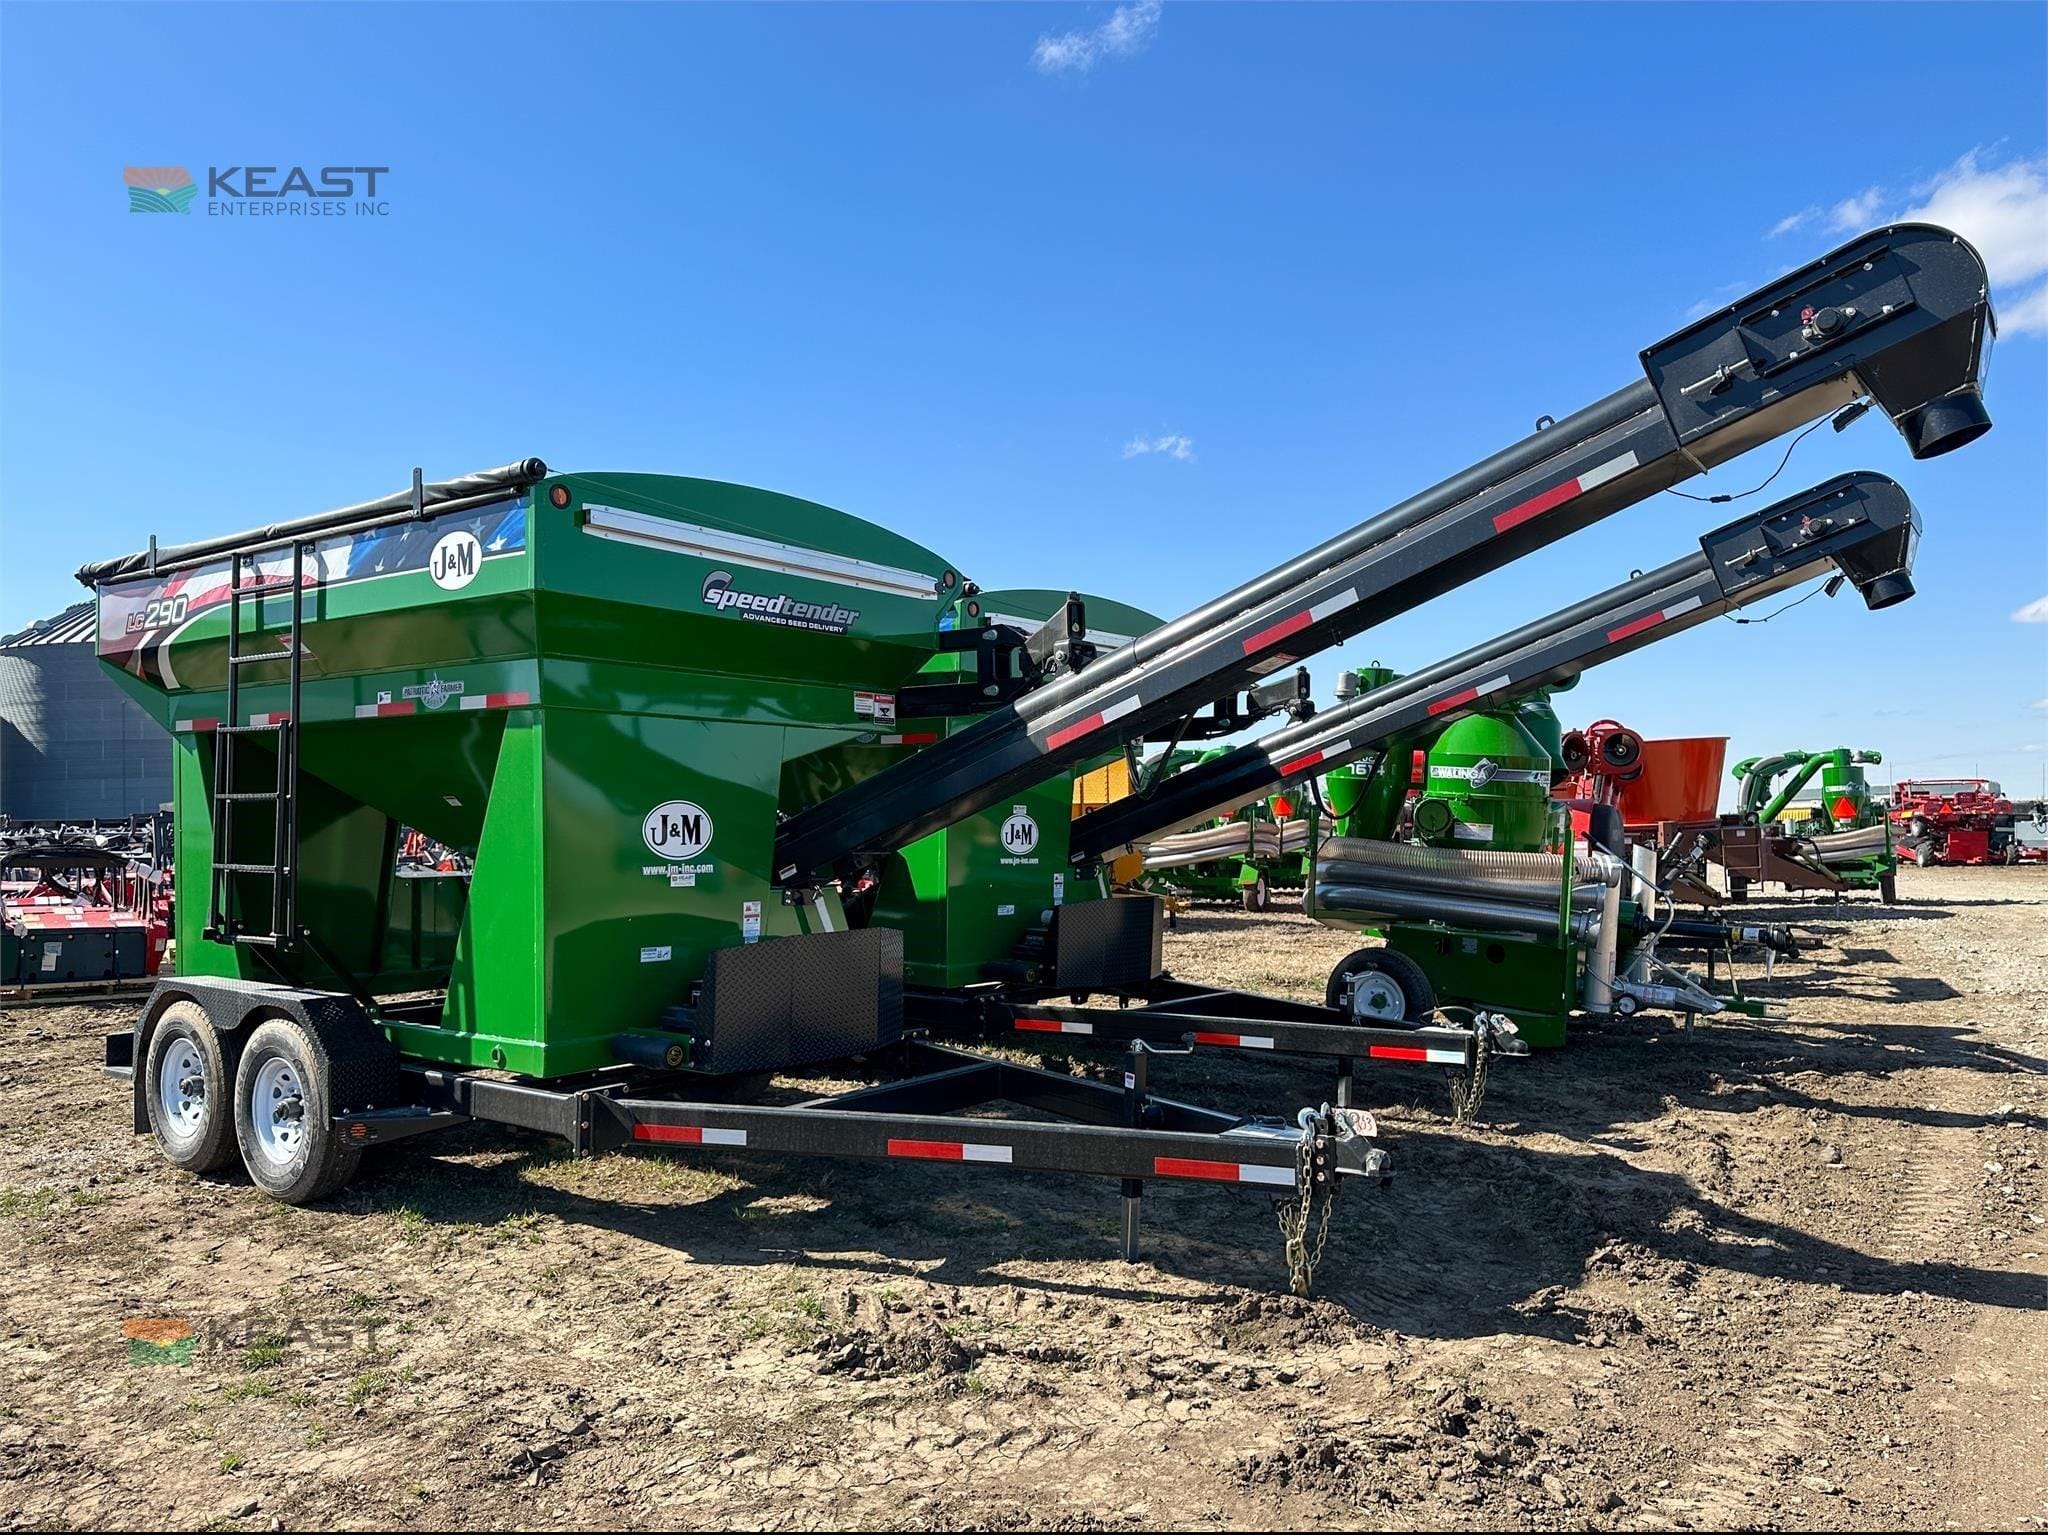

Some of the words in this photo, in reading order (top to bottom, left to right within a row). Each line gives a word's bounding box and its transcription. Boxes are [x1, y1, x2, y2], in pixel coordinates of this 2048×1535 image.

[433, 541, 474, 580] J&M
[742, 612, 787, 625] ADVANCED
[787, 619, 808, 629] SEED
[808, 622, 844, 633] DELIVERY
[1438, 767, 1487, 780] WALINGA
[650, 814, 703, 846] J&M
[1004, 823, 1033, 846] J&M
[642, 863, 714, 878] www.jm-inc.com
